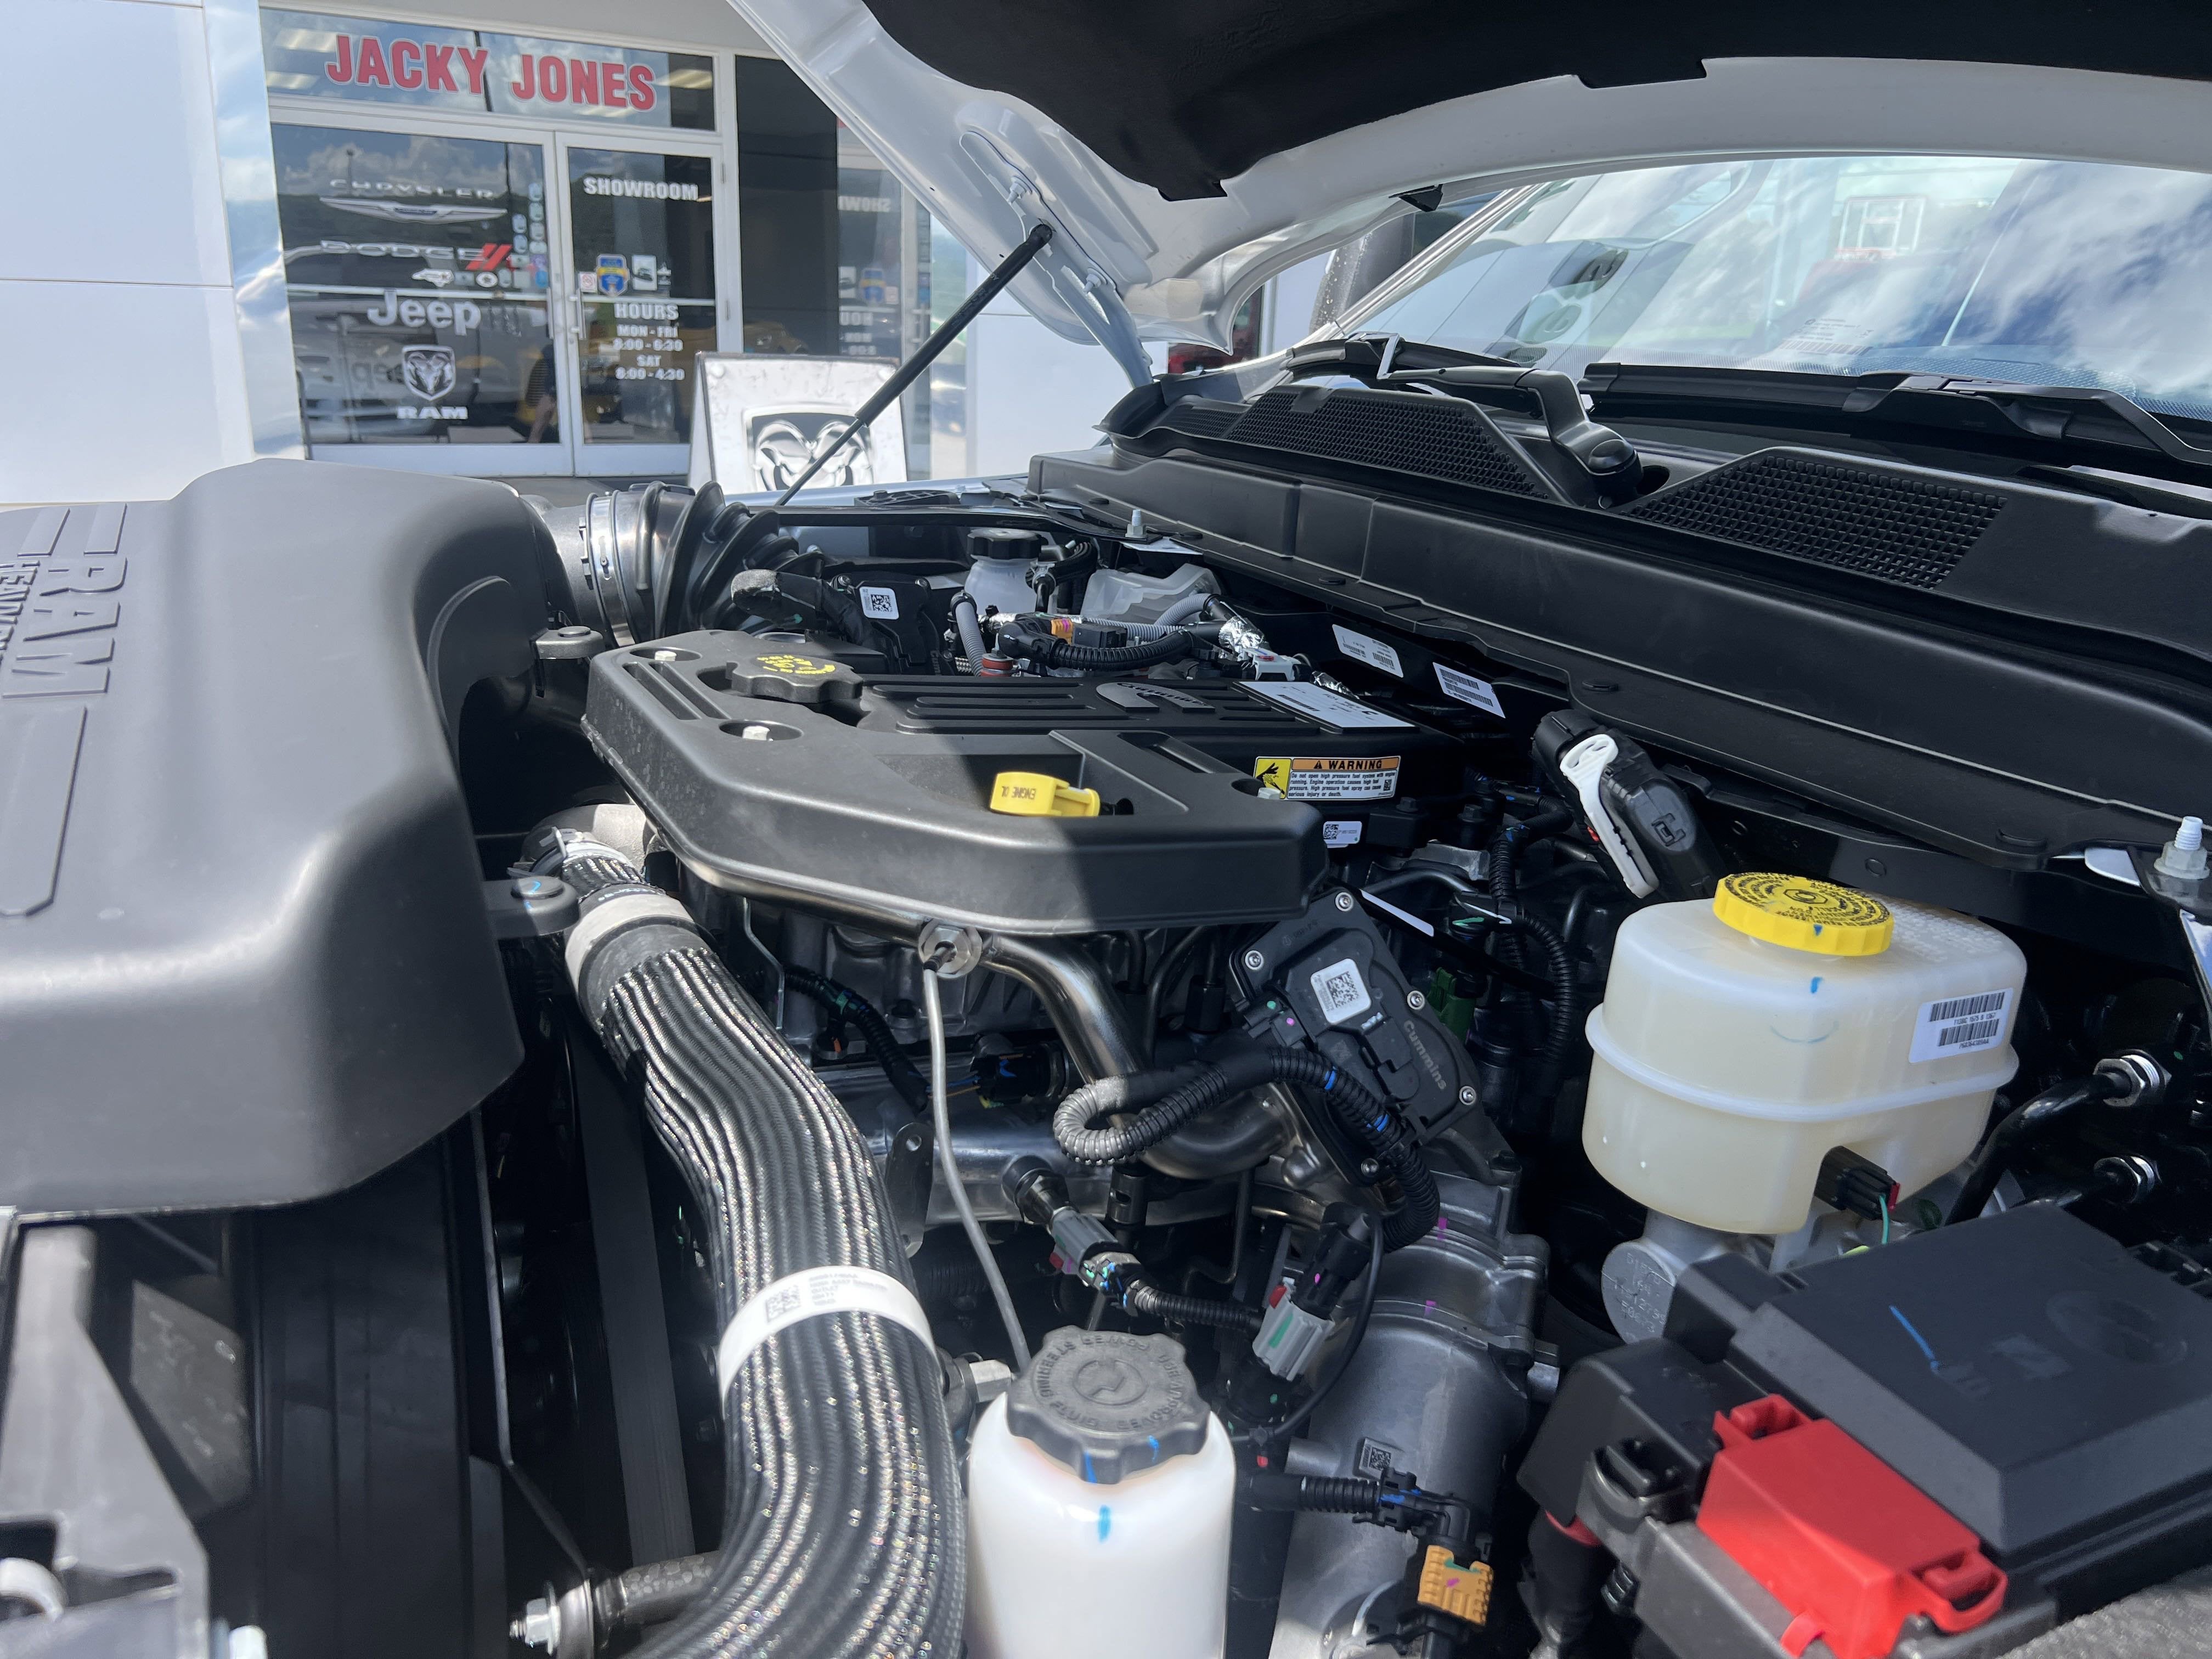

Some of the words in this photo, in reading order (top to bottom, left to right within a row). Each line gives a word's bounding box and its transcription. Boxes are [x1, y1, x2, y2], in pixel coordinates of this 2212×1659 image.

[325, 34, 489, 95] JACKY
[511, 53, 657, 112] JONES
[583, 177, 699, 201] SHOWROOM
[320, 240, 487, 261] DODGE
[367, 289, 482, 336] Jeep
[614, 302, 679, 320] HOURS
[617, 324, 648, 337] MON
[657, 325, 678, 338] FRI
[636, 354, 662, 367] SAT
[397, 406, 468, 420] RAM
[2, 557, 127, 699] RAM
[1329, 760, 1382, 769] WARNING
[1011, 787, 1037, 799] ENGINE
[1403, 1020, 1447, 1091] Cummins
[1082, 1335, 1150, 1351] POWER
[1040, 1342, 1076, 1398] STEERING
